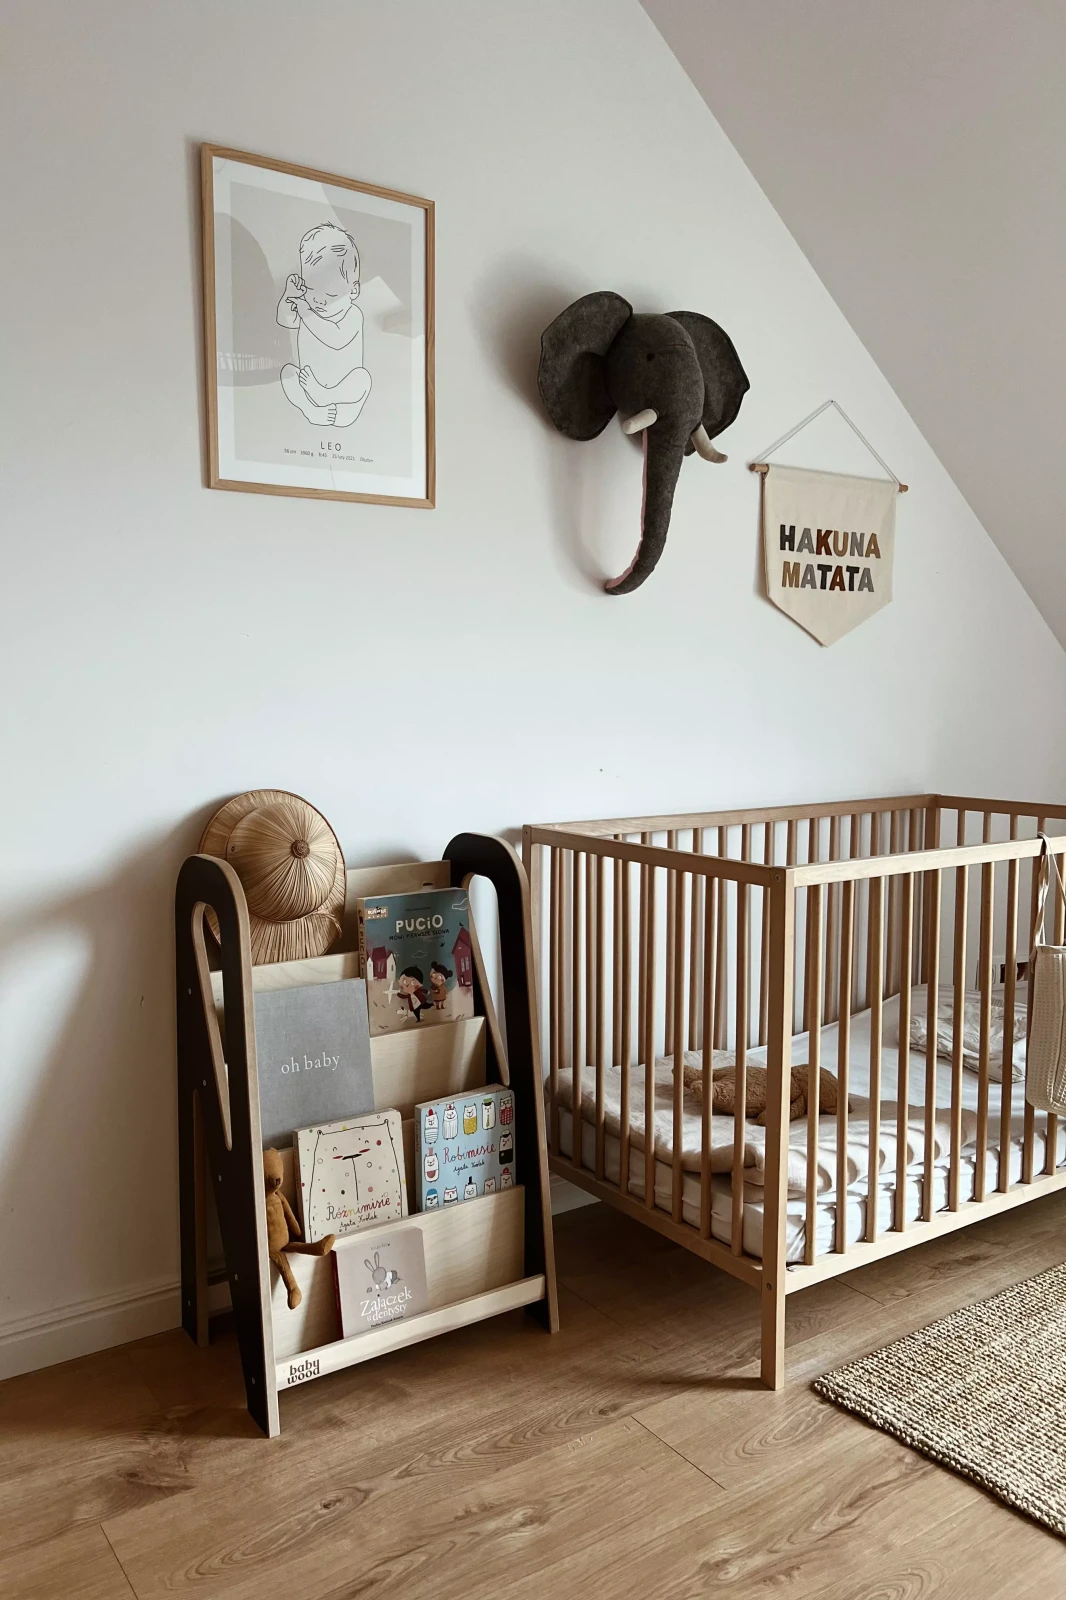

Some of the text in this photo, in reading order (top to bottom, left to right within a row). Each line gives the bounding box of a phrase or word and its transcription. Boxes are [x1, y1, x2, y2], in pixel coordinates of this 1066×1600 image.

[320, 441, 342, 452] LEO
[779, 523, 881, 559] HAKUNA
[781, 560, 875, 593] MATATA
[281, 1051, 340, 1074] oh baby
[442, 1143, 496, 1165] Robimisie
[287, 1368, 320, 1385] wood
[289, 1359, 320, 1376] baby
